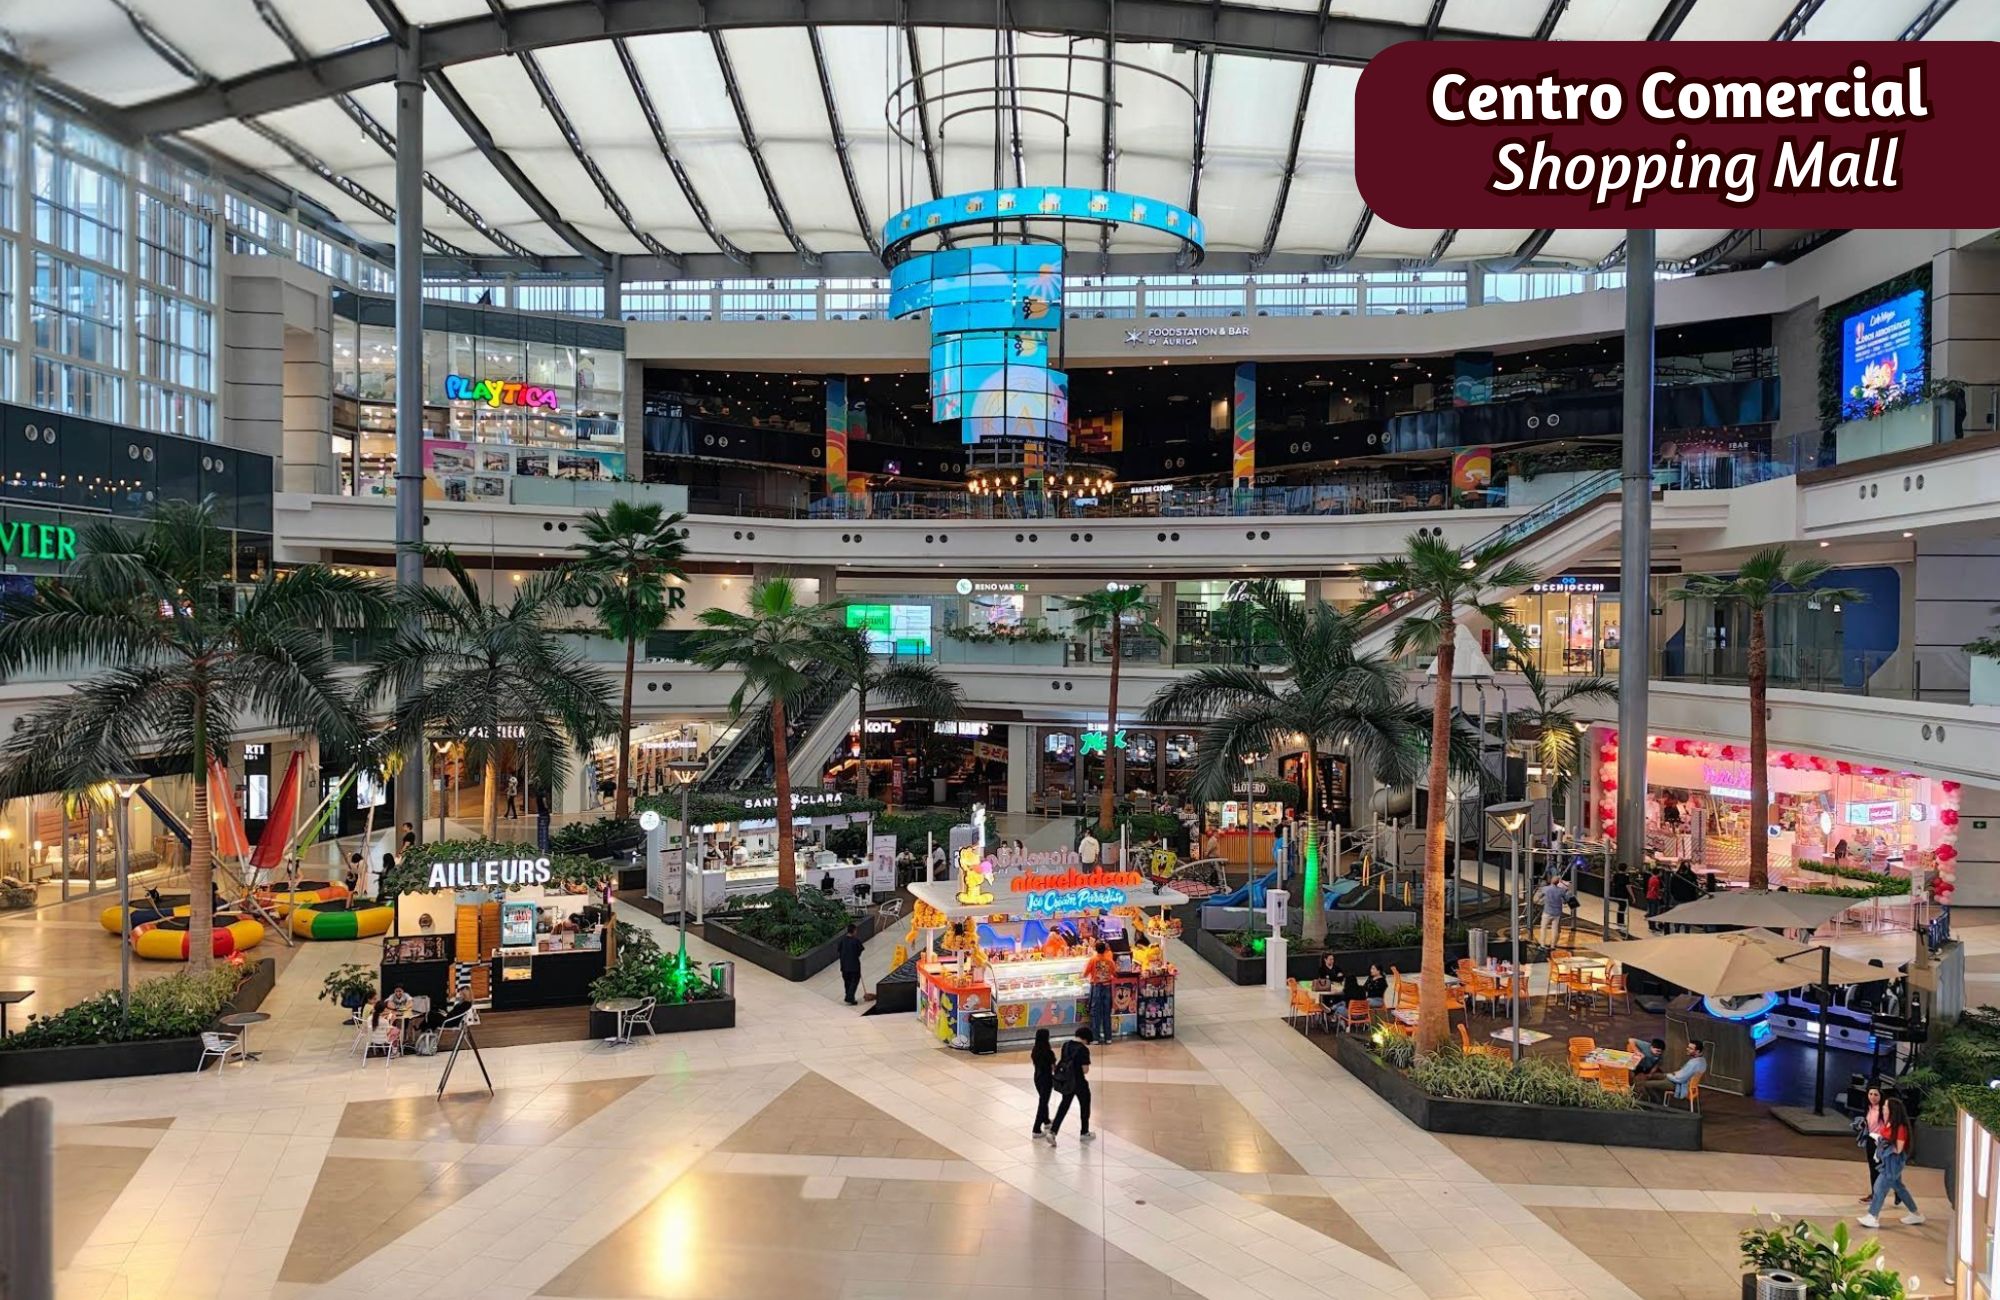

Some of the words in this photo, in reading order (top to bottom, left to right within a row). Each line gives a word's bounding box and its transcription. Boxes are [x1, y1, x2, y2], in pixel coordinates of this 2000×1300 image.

[1148, 327, 1217, 337] FOODSTATION
[1219, 327, 1226, 336] &
[1228, 326, 1250, 336] BAR
[445, 374, 558, 410] PLAYTICA
[1533, 583, 1605, 592] OCCHIOCCHI
[745, 797, 779, 809] SANT
[801, 792, 842, 805] CLARA
[428, 857, 551, 888] AILLEURS
[1010, 866, 1143, 893] nickelodeon
[1027, 892, 1044, 911] Ice
[1044, 890, 1078, 909] Cream
[1078, 888, 1124, 908] Paradise
